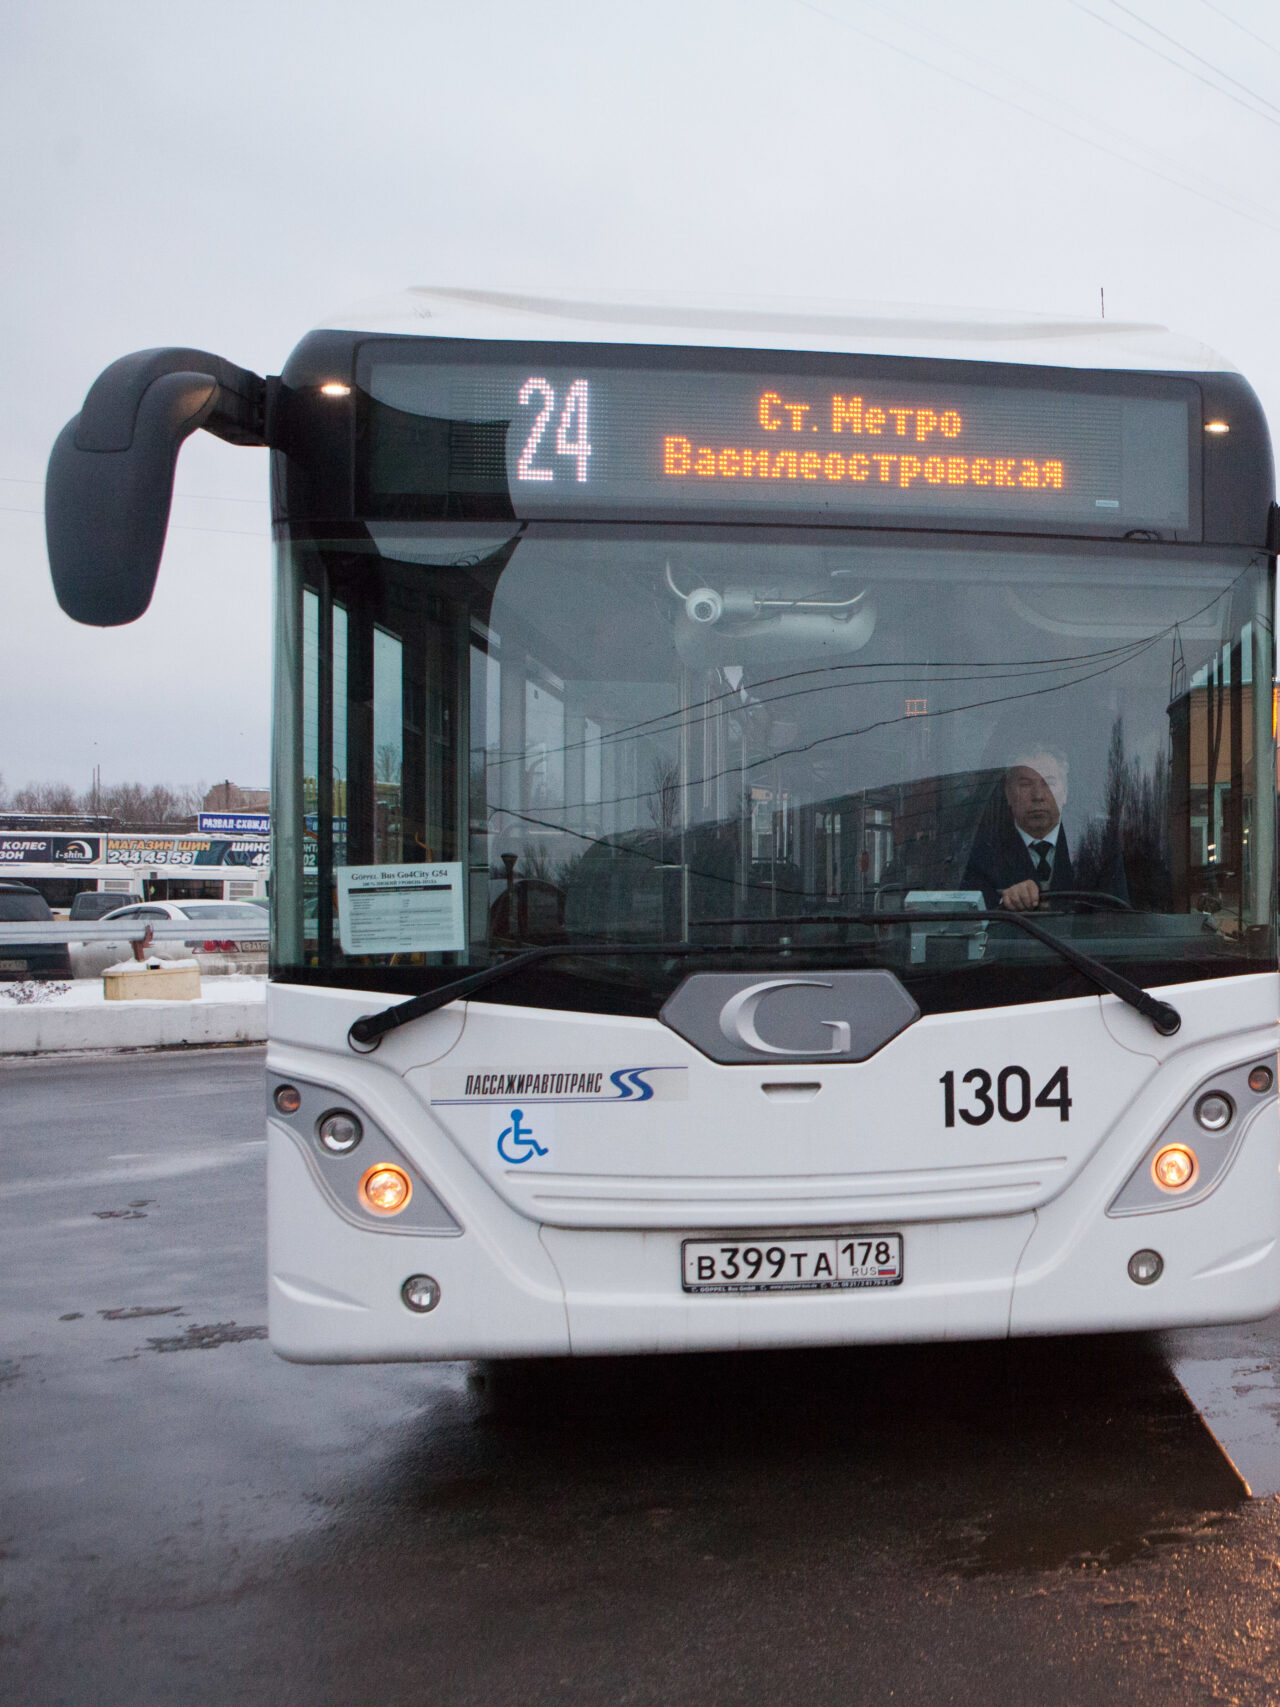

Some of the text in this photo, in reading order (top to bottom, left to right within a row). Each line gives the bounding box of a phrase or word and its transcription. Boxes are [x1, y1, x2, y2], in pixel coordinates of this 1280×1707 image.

[759, 392, 962, 442] Ст. Метро
[517, 377, 593, 483] 24
[663, 435, 1064, 489] Василеостровская
[2, 841, 47, 850] КОЛЕС
[108, 840, 210, 851] МАГАЗИН ШИН
[108, 852, 194, 864] 244 45 56
[431, 869, 448, 877] G54
[464, 1072, 602, 1095] ПАССАЖИРАВТОТРАНС
[939, 1065, 1072, 1128] 1304
[697, 1241, 890, 1281] В399ТА 178
[851, 1267, 877, 1276] RUS
